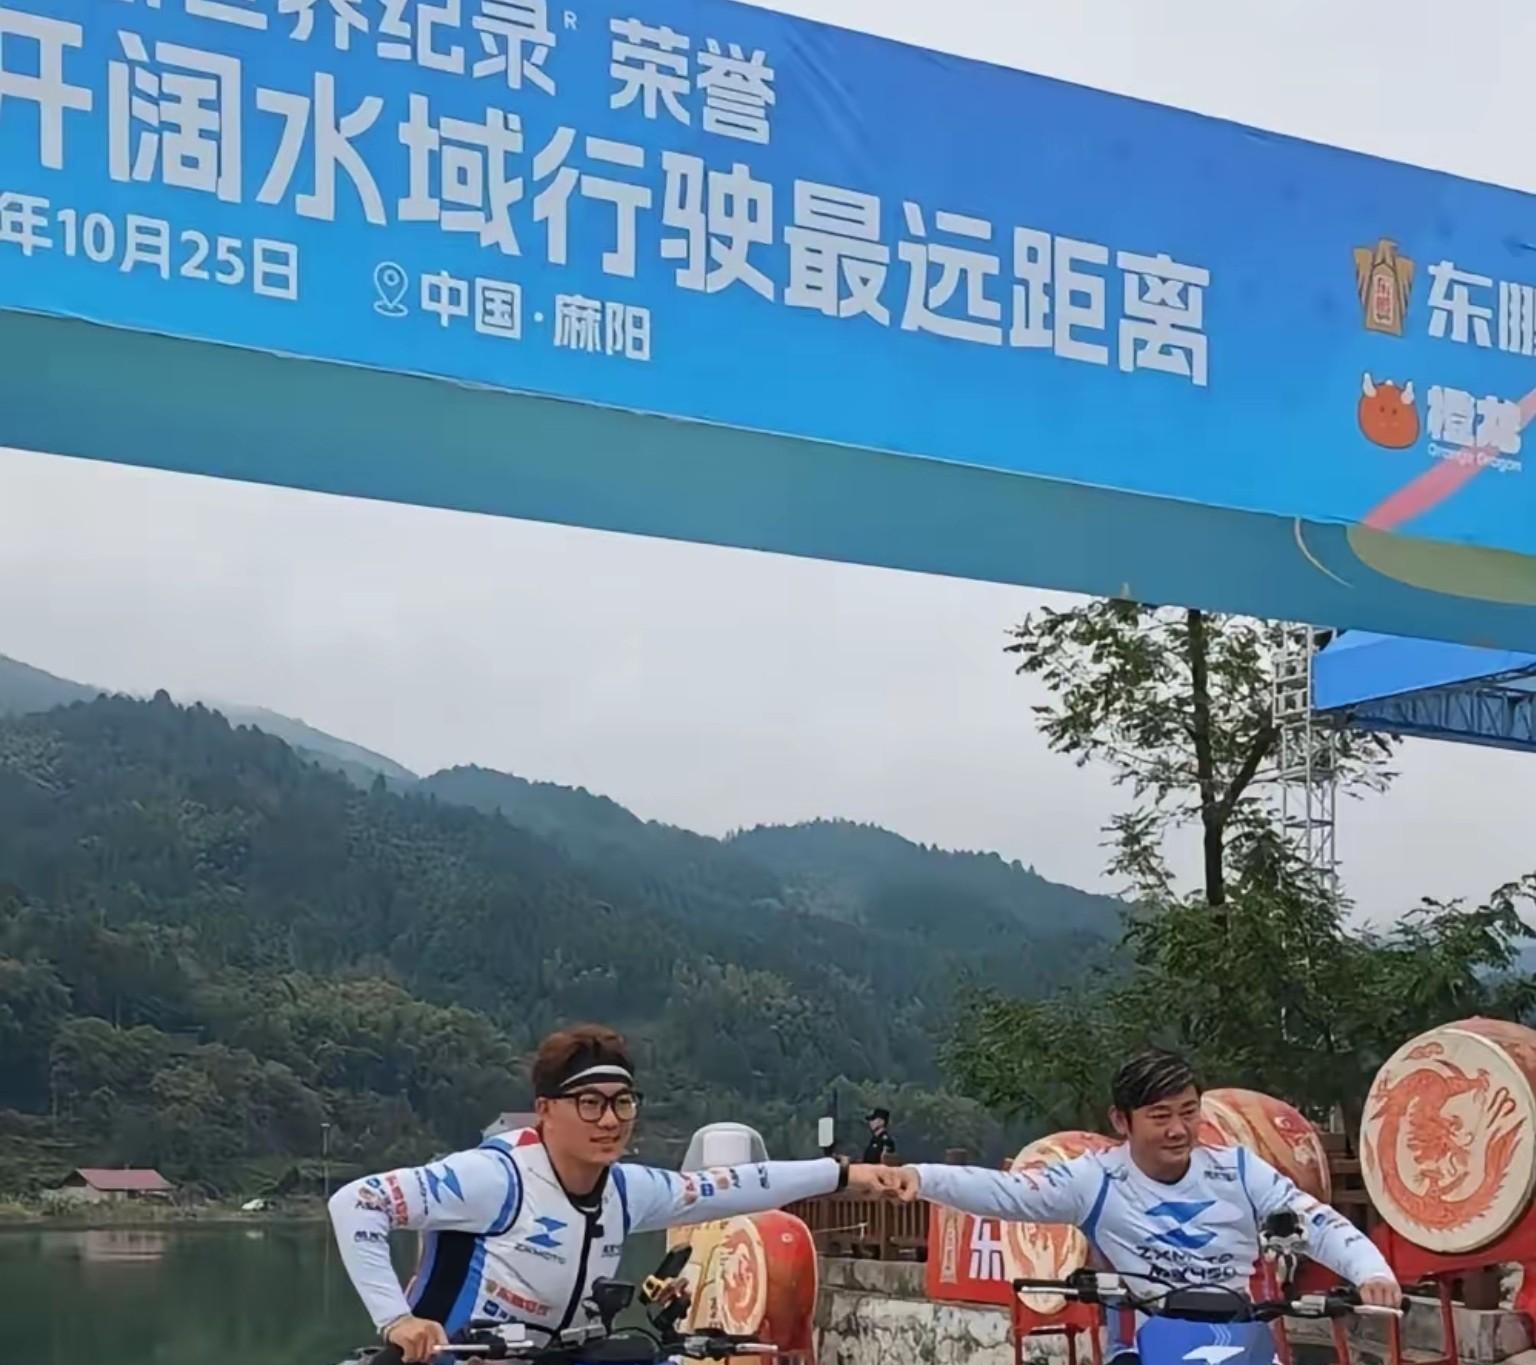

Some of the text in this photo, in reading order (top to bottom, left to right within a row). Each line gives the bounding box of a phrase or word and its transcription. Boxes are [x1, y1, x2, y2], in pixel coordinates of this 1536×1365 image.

[0, 10, 1210, 388] 开阔水域行驶最远距离
[609, 18, 776, 145] 荣誉
